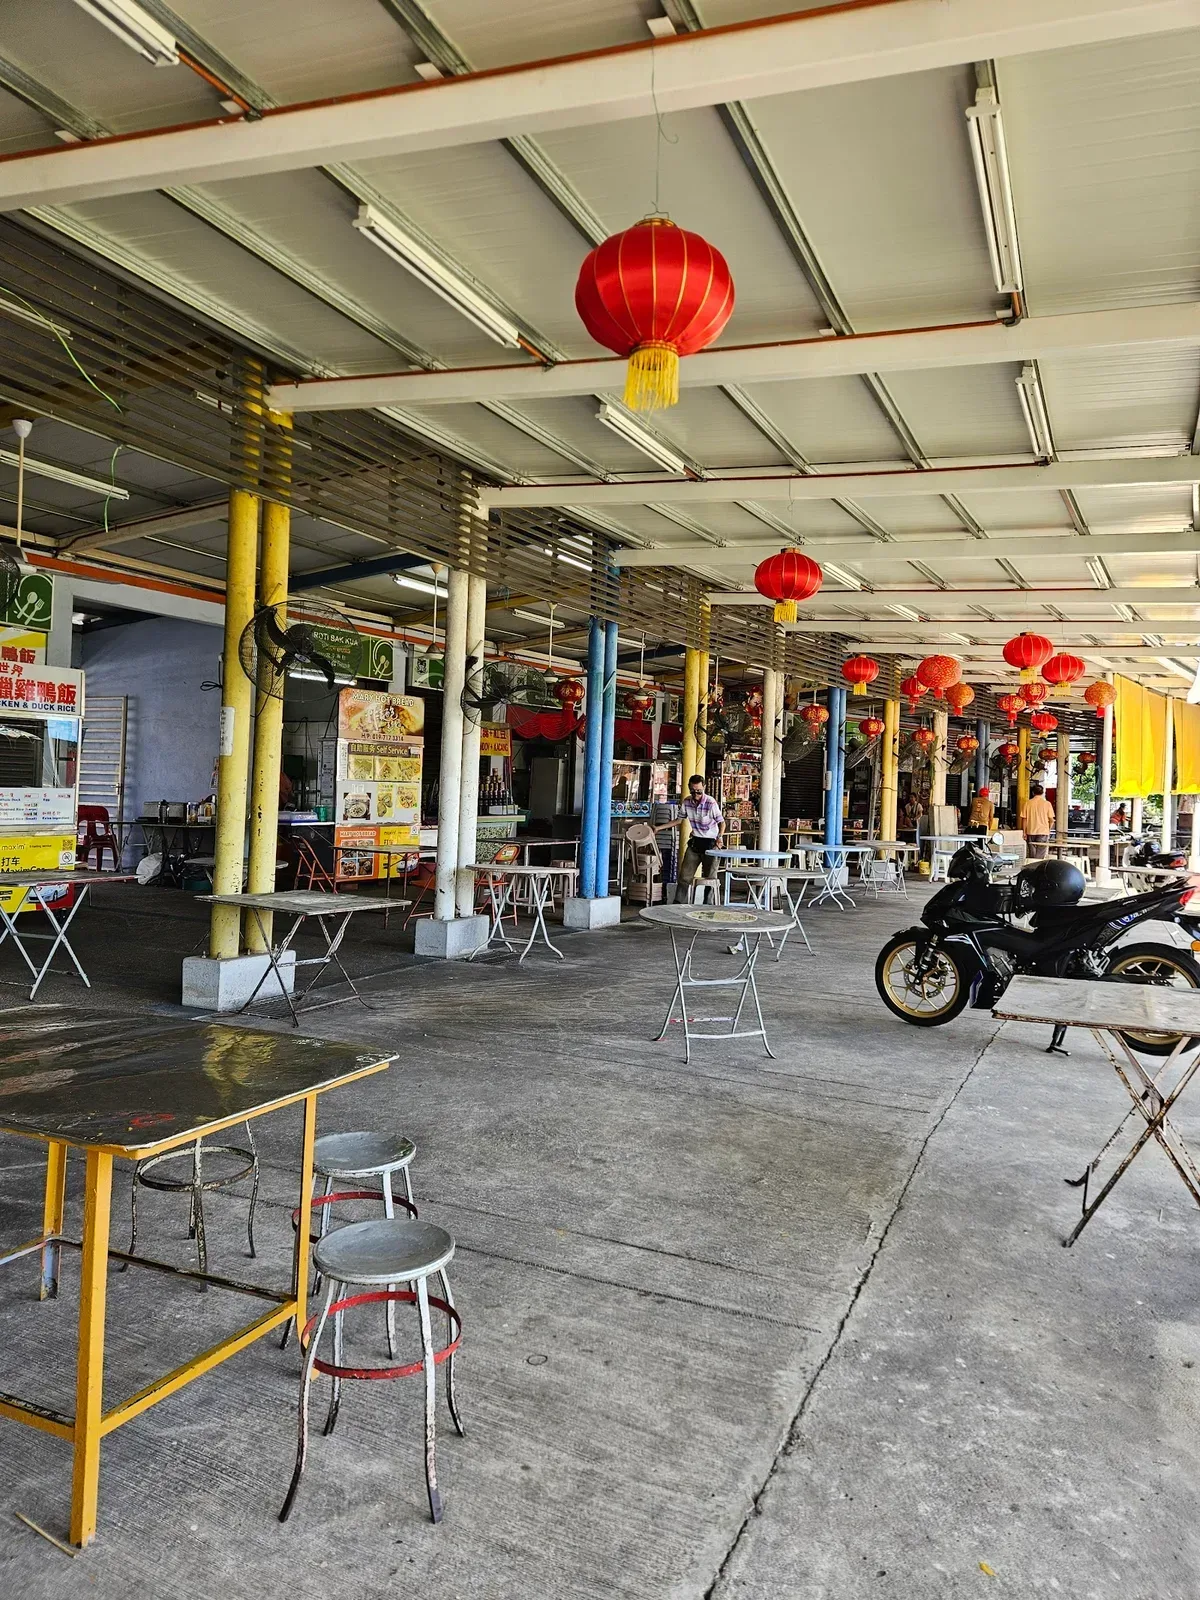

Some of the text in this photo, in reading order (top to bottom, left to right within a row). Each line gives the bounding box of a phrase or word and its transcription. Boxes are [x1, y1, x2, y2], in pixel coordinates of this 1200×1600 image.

[312, 631, 329, 640] ROTI
[352, 693, 414, 707] MARY HOT BREAD
[0, 700, 20, 708] KEN
[32, 703, 55, 711] DUCK
[377, 745, 388, 753] Self
[388, 746, 408, 755] Service
[1, 843, 25, 851] maxim
[1, 856, 20, 867] 打车
